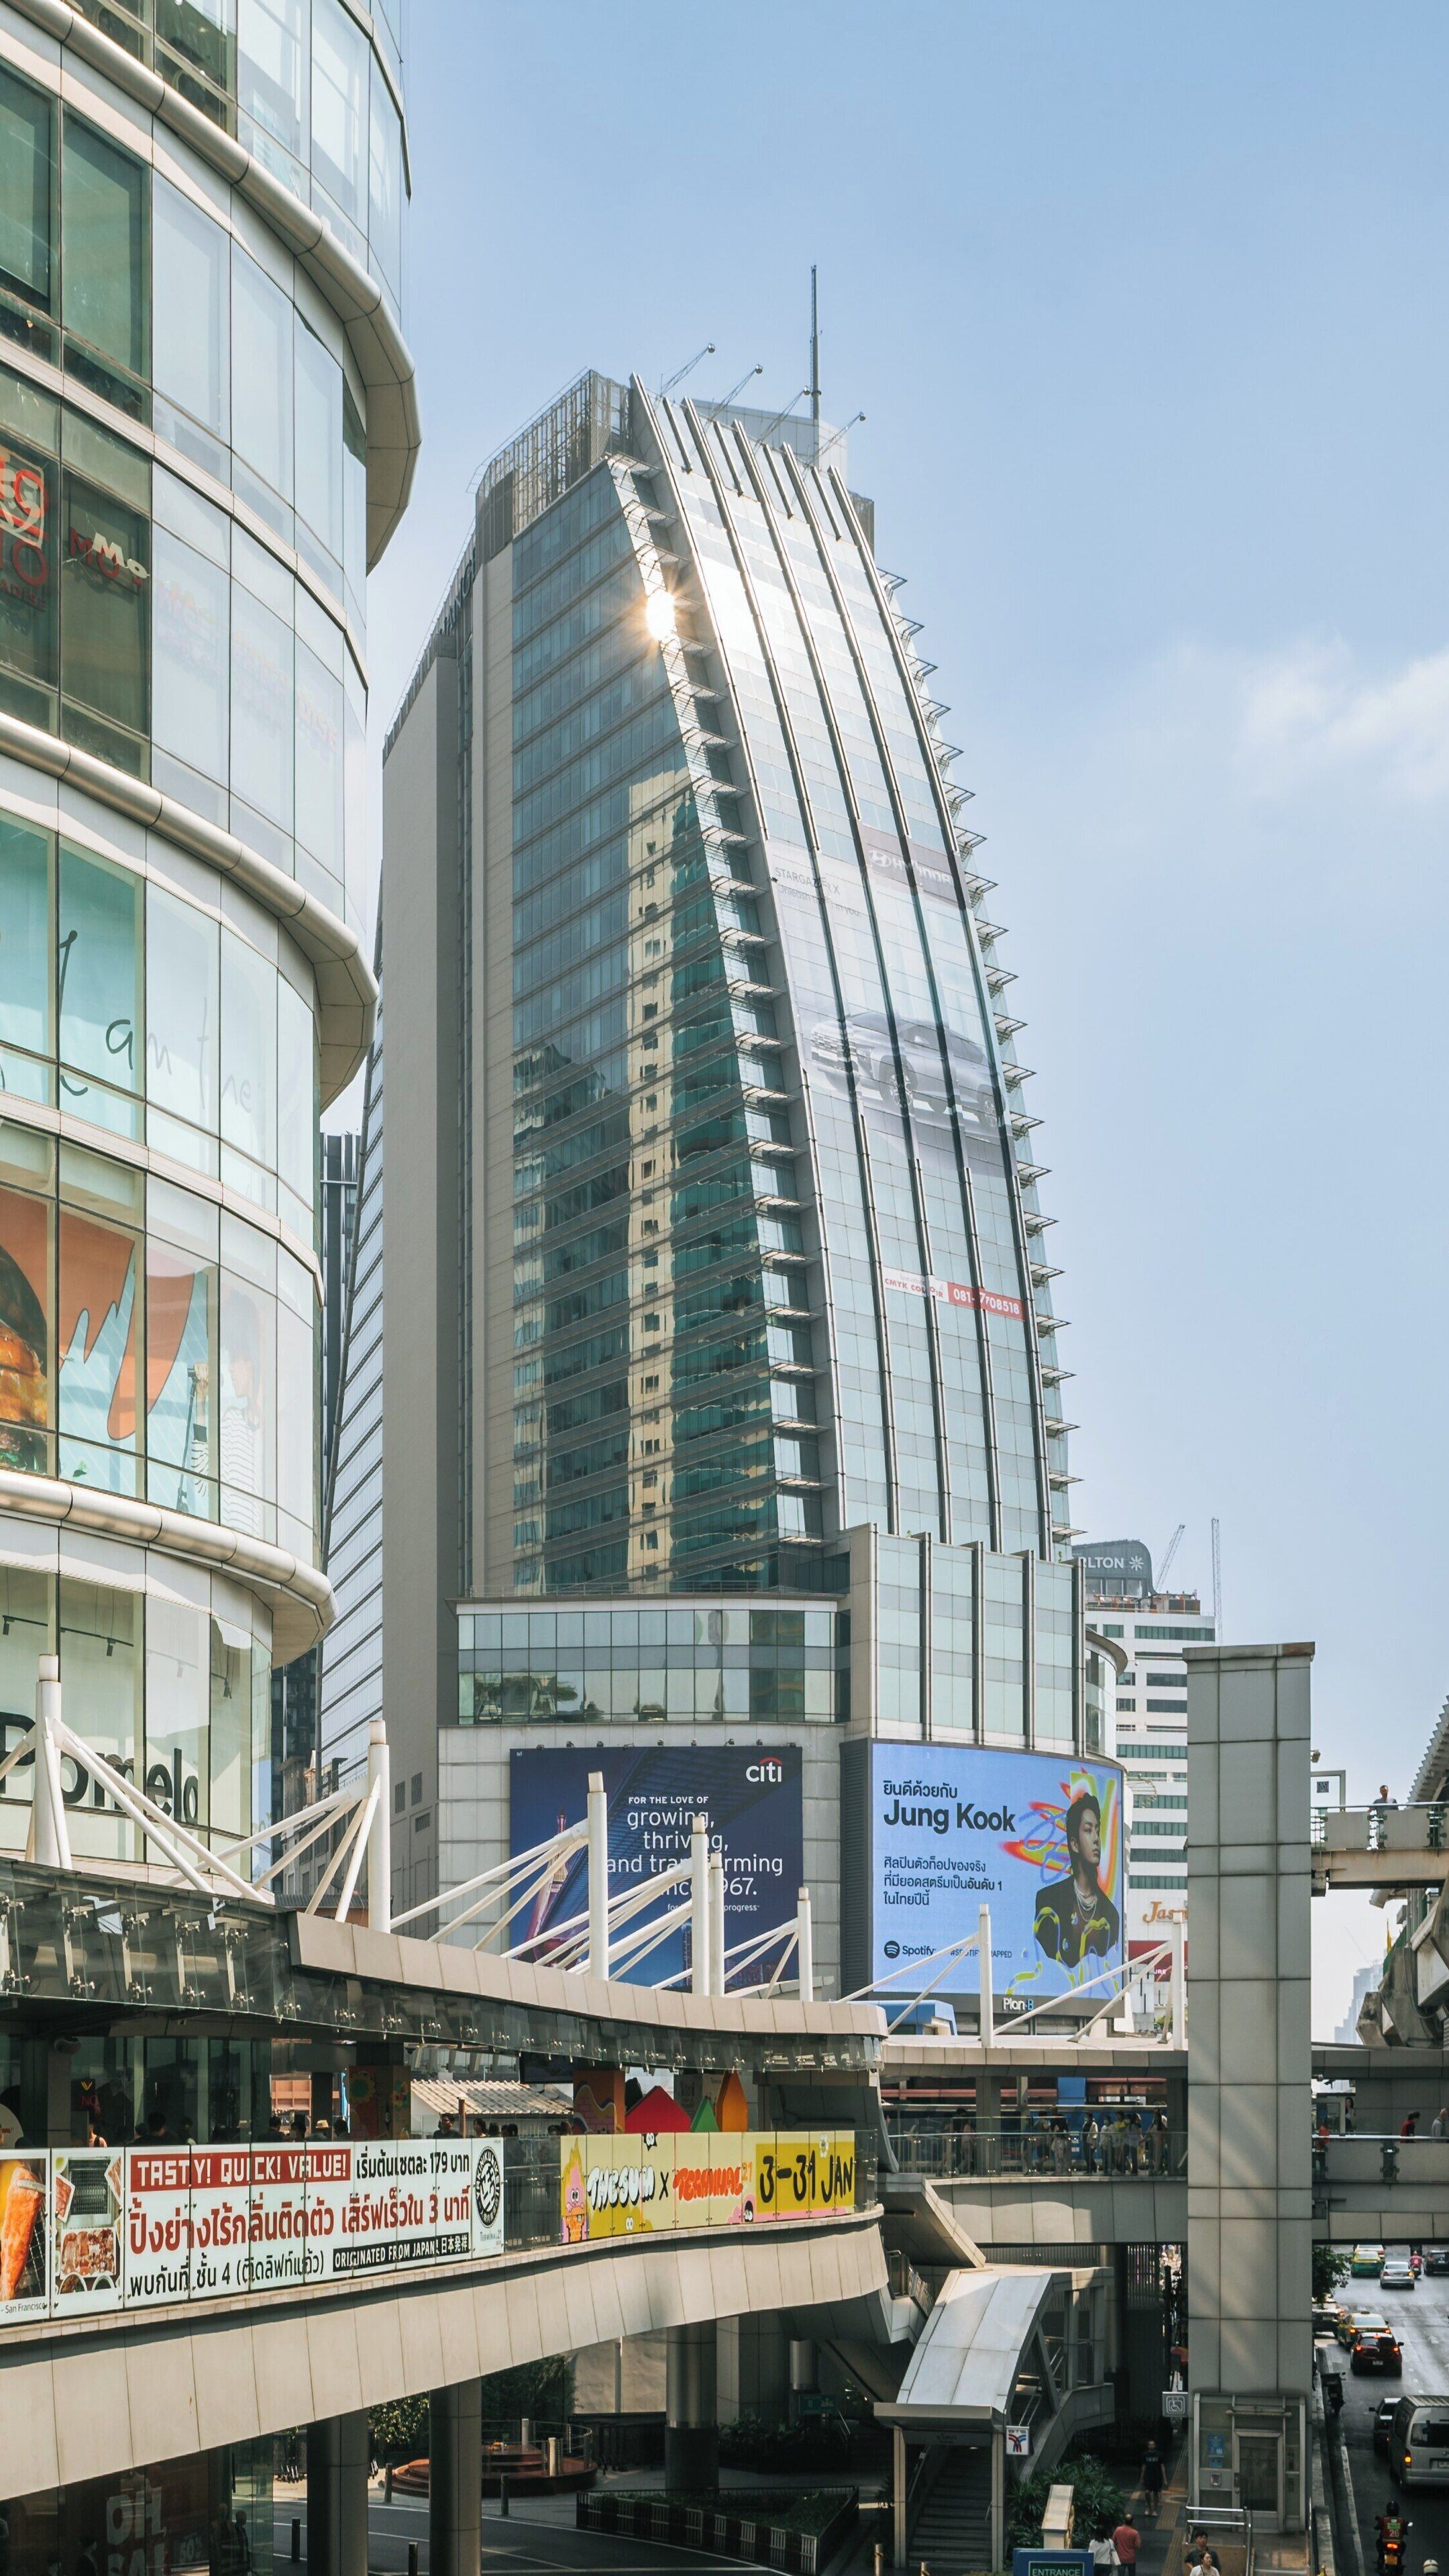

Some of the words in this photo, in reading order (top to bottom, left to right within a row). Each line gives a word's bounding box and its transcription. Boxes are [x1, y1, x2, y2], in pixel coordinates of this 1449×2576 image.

[885, 1278, 908, 1290] CMYK
[746, 1760, 782, 1782] citi
[883, 1780, 958, 1799] ยินดีด้วยกับ
[629, 1796, 647, 1805] FOR
[649, 1796, 667, 1804] THE
[670, 1796, 694, 1804] LOVE
[696, 1796, 709, 1804] OF
[883, 1799, 949, 1834] Jung
[957, 1803, 1016, 1832] Kook
[643, 1831, 729, 1852] thrivg,
[884, 1856, 986, 1872] ศิลปินตัวท็อปของจริง
[998, 1881, 1002, 1891] 1
[883, 1889, 930, 1906] ในไทยปีนี้
[902, 1945, 934, 1956] Spotify
[137, 2157, 211, 2187] TASTY!
[220, 2155, 281, 2185] QUICK!
[288, 2154, 346, 2179] VALUE!
[430, 2151, 448, 2174] 179
[451, 2153, 470, 2173] บาท
[759, 2149, 816, 2204] 3-31
[820, 2154, 853, 2204] JAN
[129, 2192, 335, 2255] ปิ้งย่างไร้กลิ่นติดตัว
[429, 2194, 439, 2224] 3
[444, 2186, 469, 2222] นาที
[441, 2235, 468, 2254] 日本発祥
[335, 2246, 386, 2268] ORIGINATED
[388, 2243, 410, 2261] FROM
[129, 2255, 190, 2297] พบกันที่
[196, 2252, 217, 2288] ชั้น
[221, 2262, 230, 2285] 4
